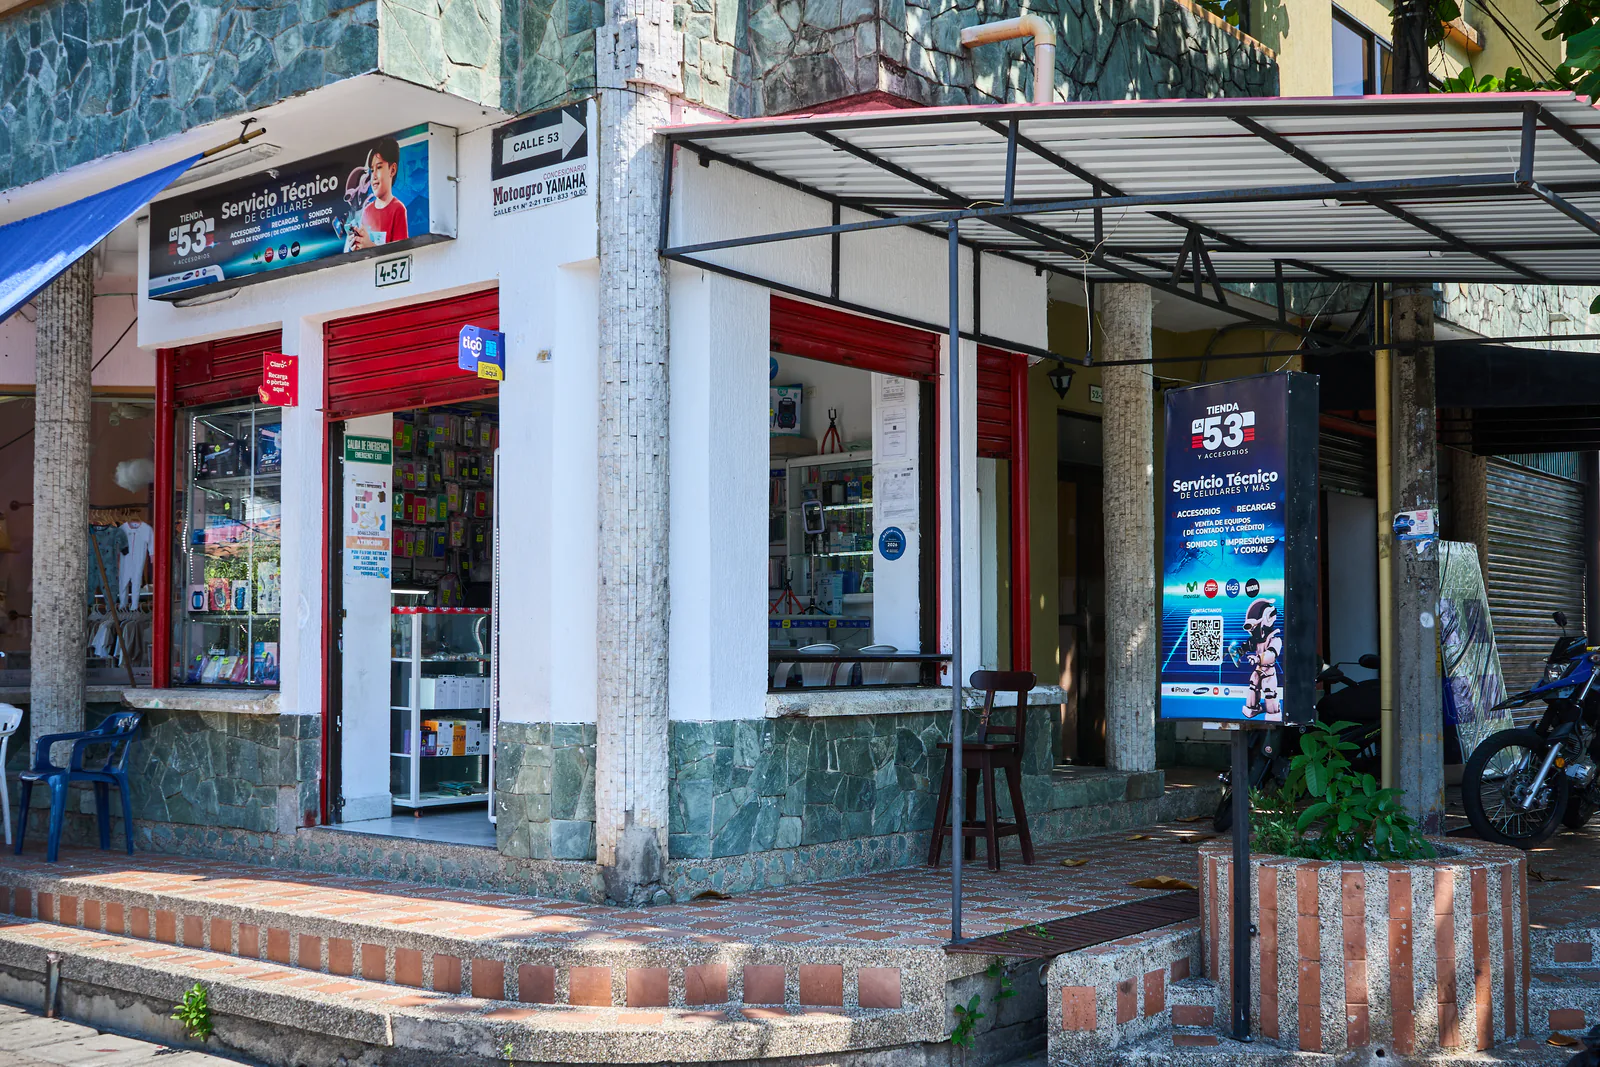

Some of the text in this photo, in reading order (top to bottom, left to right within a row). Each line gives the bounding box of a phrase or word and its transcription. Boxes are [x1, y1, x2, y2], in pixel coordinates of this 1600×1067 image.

[513, 132, 559, 152] CALLE 53
[543, 164, 586, 180] CONCESIONARIO
[221, 174, 338, 220] Servicio Técnico
[493, 172, 586, 206] Motoagro YAMAHA
[244, 198, 313, 224] DE CELULARES
[494, 207, 512, 216] CALLE
[529, 199, 540, 208] 2-21
[557, 192, 568, 200] 833
[180, 210, 204, 223] TIENDA
[230, 207, 333, 239] ACCESORIOS RECARGAS SONIDOS
[177, 220, 206, 256] 53
[232, 237, 246, 246] VENTA
[252, 232, 270, 242] EQUIPOS
[280, 224, 300, 234] CONTADO
[178, 253, 210, 264] ACCESORIOS
[380, 261, 406, 282] 4-57
[462, 336, 482, 351] tigo
[268, 372, 288, 380] Recarga
[1206, 402, 1239, 415] TIENDA
[1202, 413, 1244, 451] 53
[362, 440, 366, 450] DE
[1204, 448, 1249, 459] ACCESORIOS
[1172, 469, 1278, 492] Servicio Técnico
[1194, 486, 1241, 498] CELULARES
[1252, 483, 1270, 492] MÁS
[1176, 502, 1276, 518] ACCESORIOS RECARGAS
[1194, 520, 1213, 528] VENTA
[1224, 517, 1251, 526] EQUIPOS
[1196, 527, 1224, 535] CONTADO
[1236, 523, 1264, 532] CRÉDITO)
[1186, 535, 1275, 548] SONIDOS IMPRESIÓNES
[1227, 583, 1238, 591] tigo
